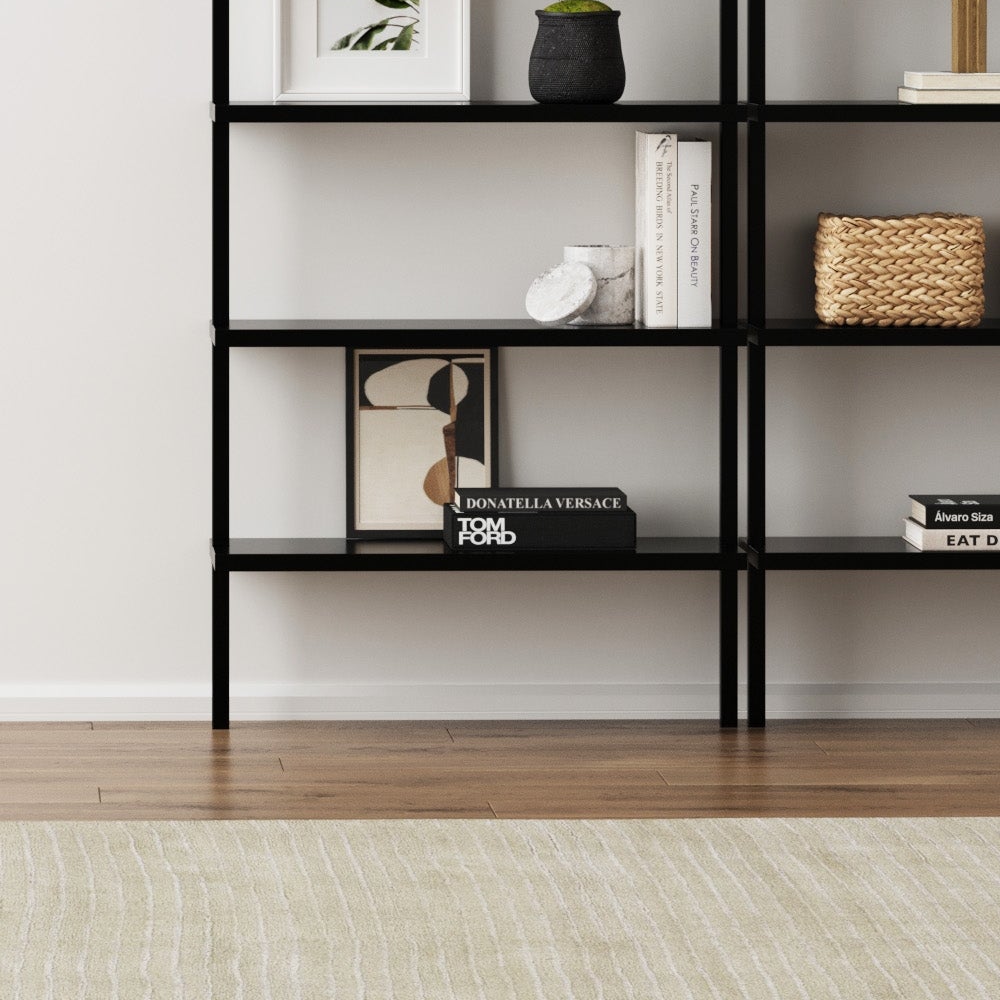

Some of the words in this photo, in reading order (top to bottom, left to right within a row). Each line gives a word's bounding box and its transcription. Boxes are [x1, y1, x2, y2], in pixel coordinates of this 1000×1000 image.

[655, 161, 664, 202] BREEDING
[690, 184, 700, 207] PAUL
[655, 205, 664, 230] BIRDS
[690, 208, 700, 235] STARR
[655, 233, 664, 241] IN
[690, 237, 700, 253] ON
[655, 245, 664, 262] NEW
[655, 264, 664, 287] YORK
[690, 255, 699, 288] BEAUTY
[655, 290, 664, 315] STATE
[466, 497, 553, 510] DONATELLA
[555, 497, 622, 510] VERSACE
[457, 517, 506, 532] TOM
[934, 510, 969, 522] Álvaro
[971, 512, 994, 522] Siza
[458, 531, 517, 546] FORD
[946, 535, 980, 546] EAT
